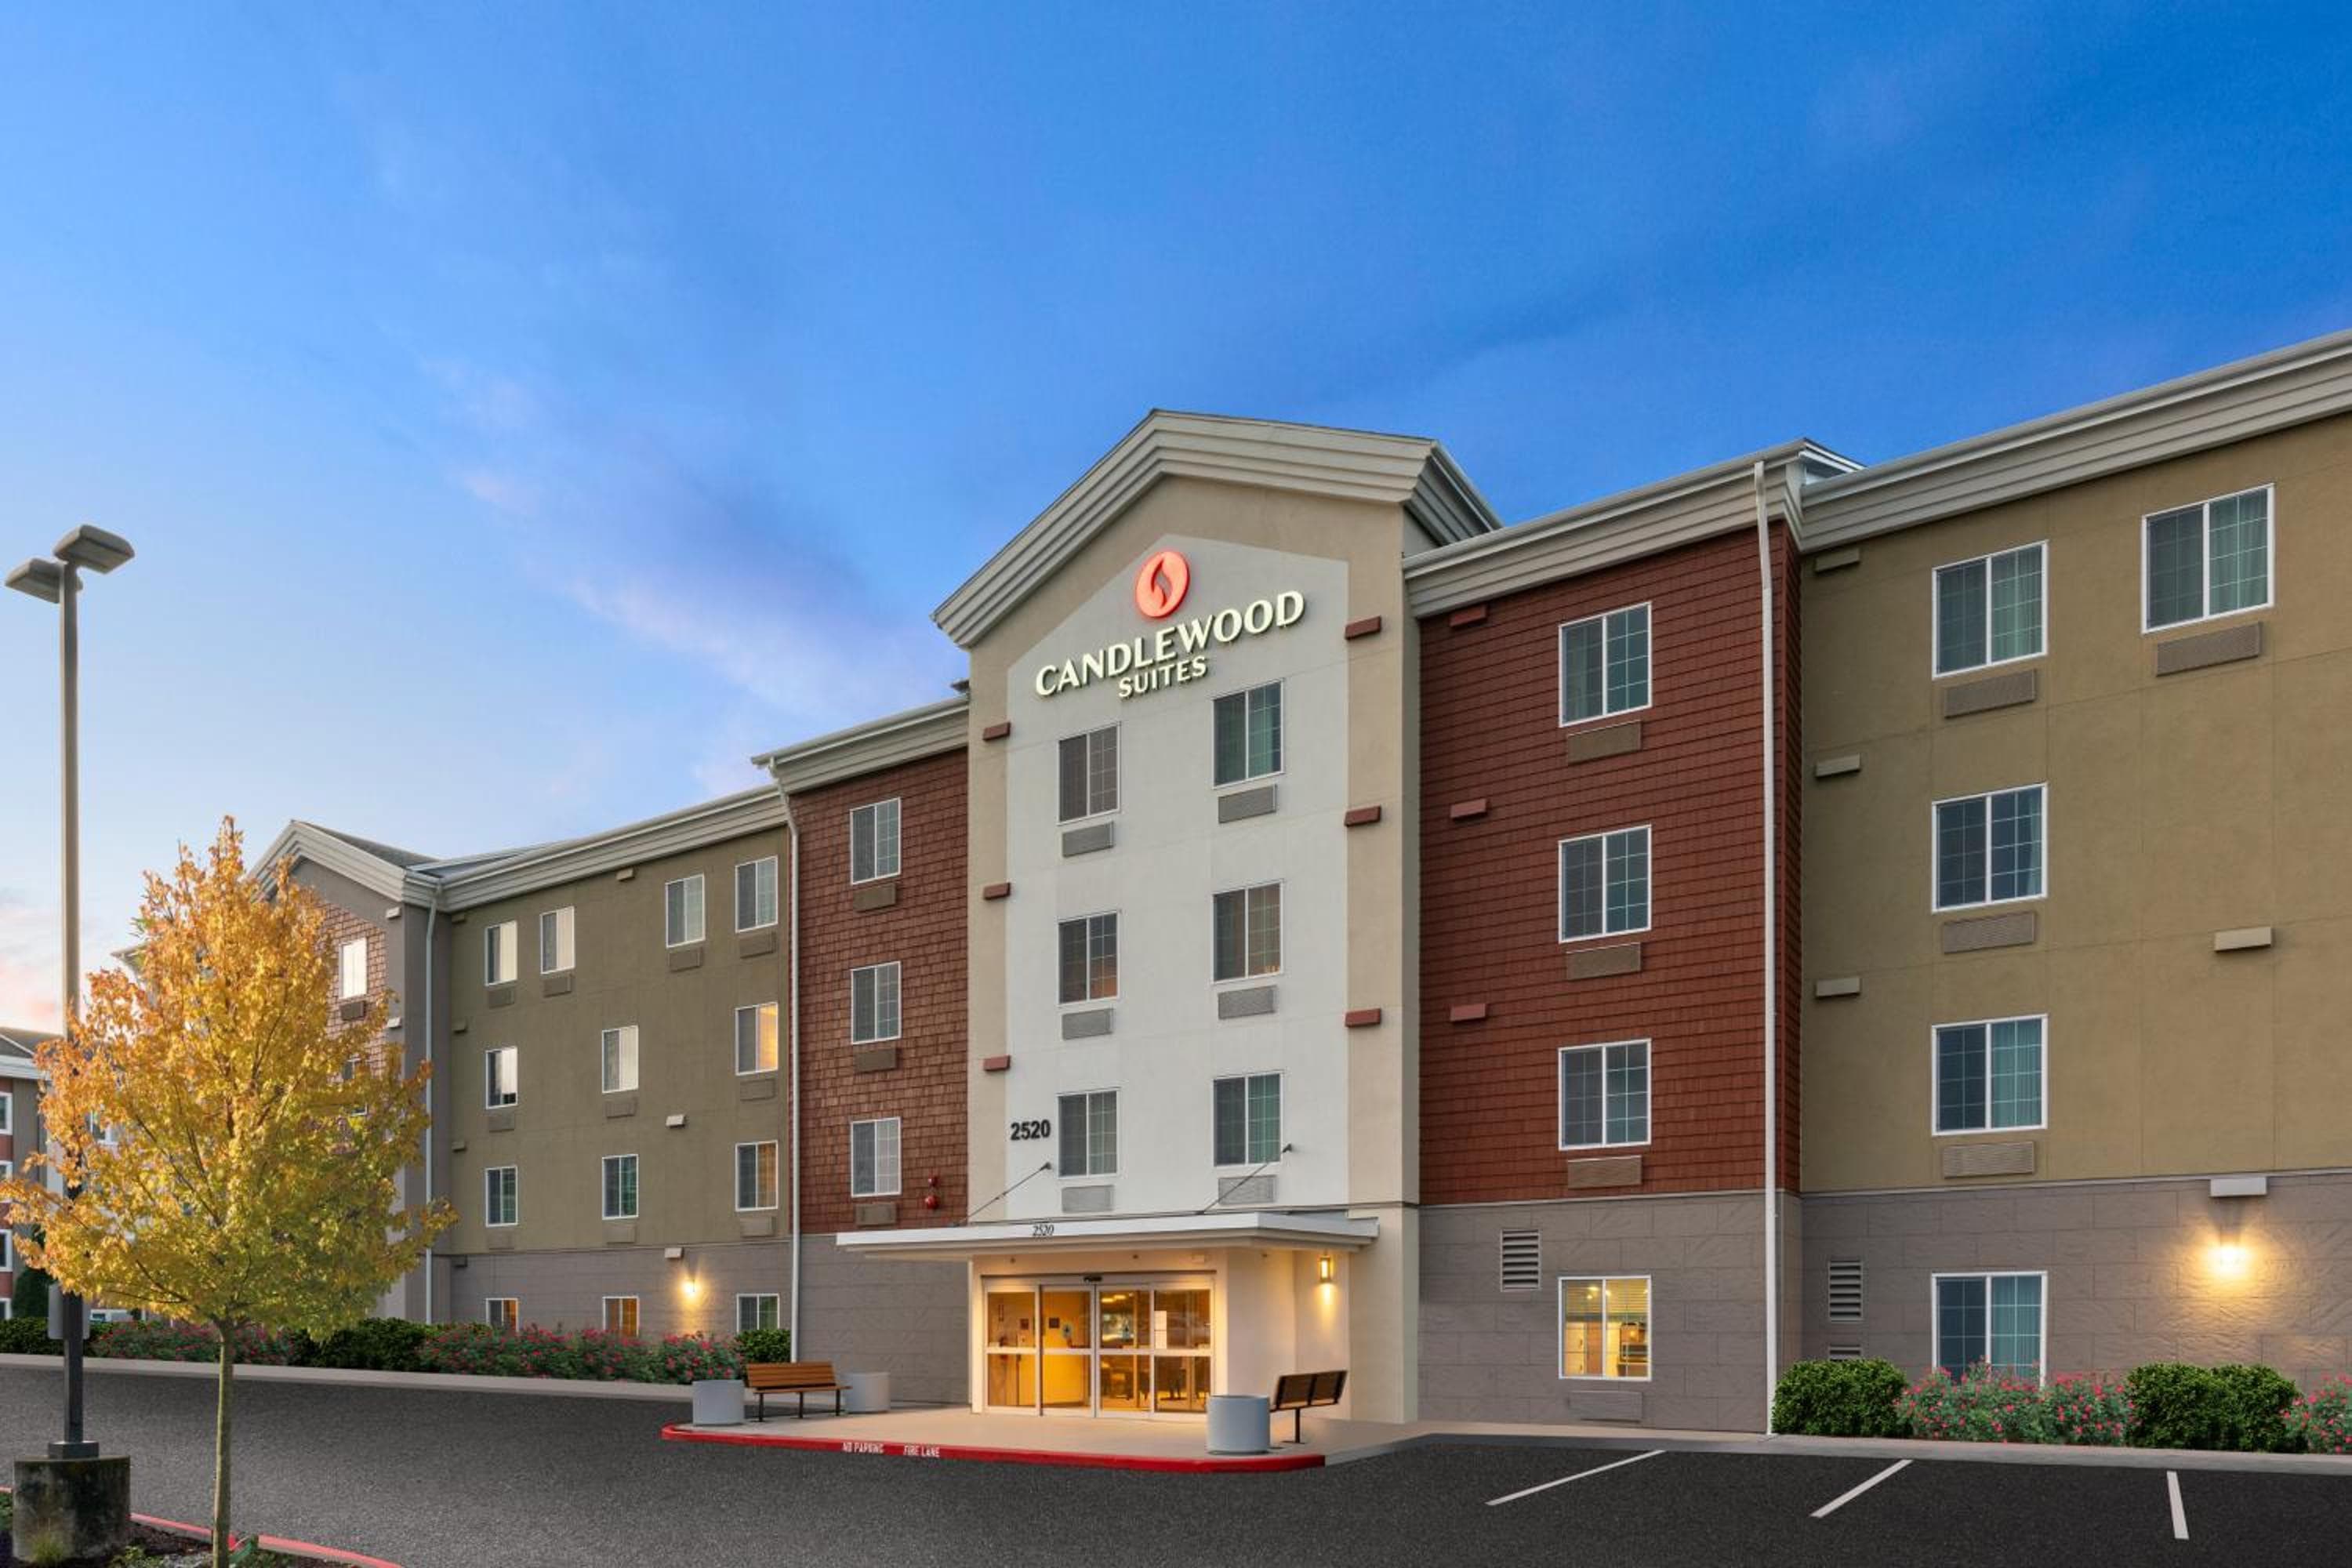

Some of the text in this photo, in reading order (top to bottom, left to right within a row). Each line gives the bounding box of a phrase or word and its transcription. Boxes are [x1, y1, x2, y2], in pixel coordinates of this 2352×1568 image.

[1035, 590, 1306, 697] CANDLEWOOD
[1118, 655, 1208, 699] SUITES
[1011, 1120, 1051, 1141] 2520
[1033, 1225, 1054, 1236] 2520
[843, 1442, 884, 1454] NO PARKING
[921, 1446, 940, 1457] LANE
